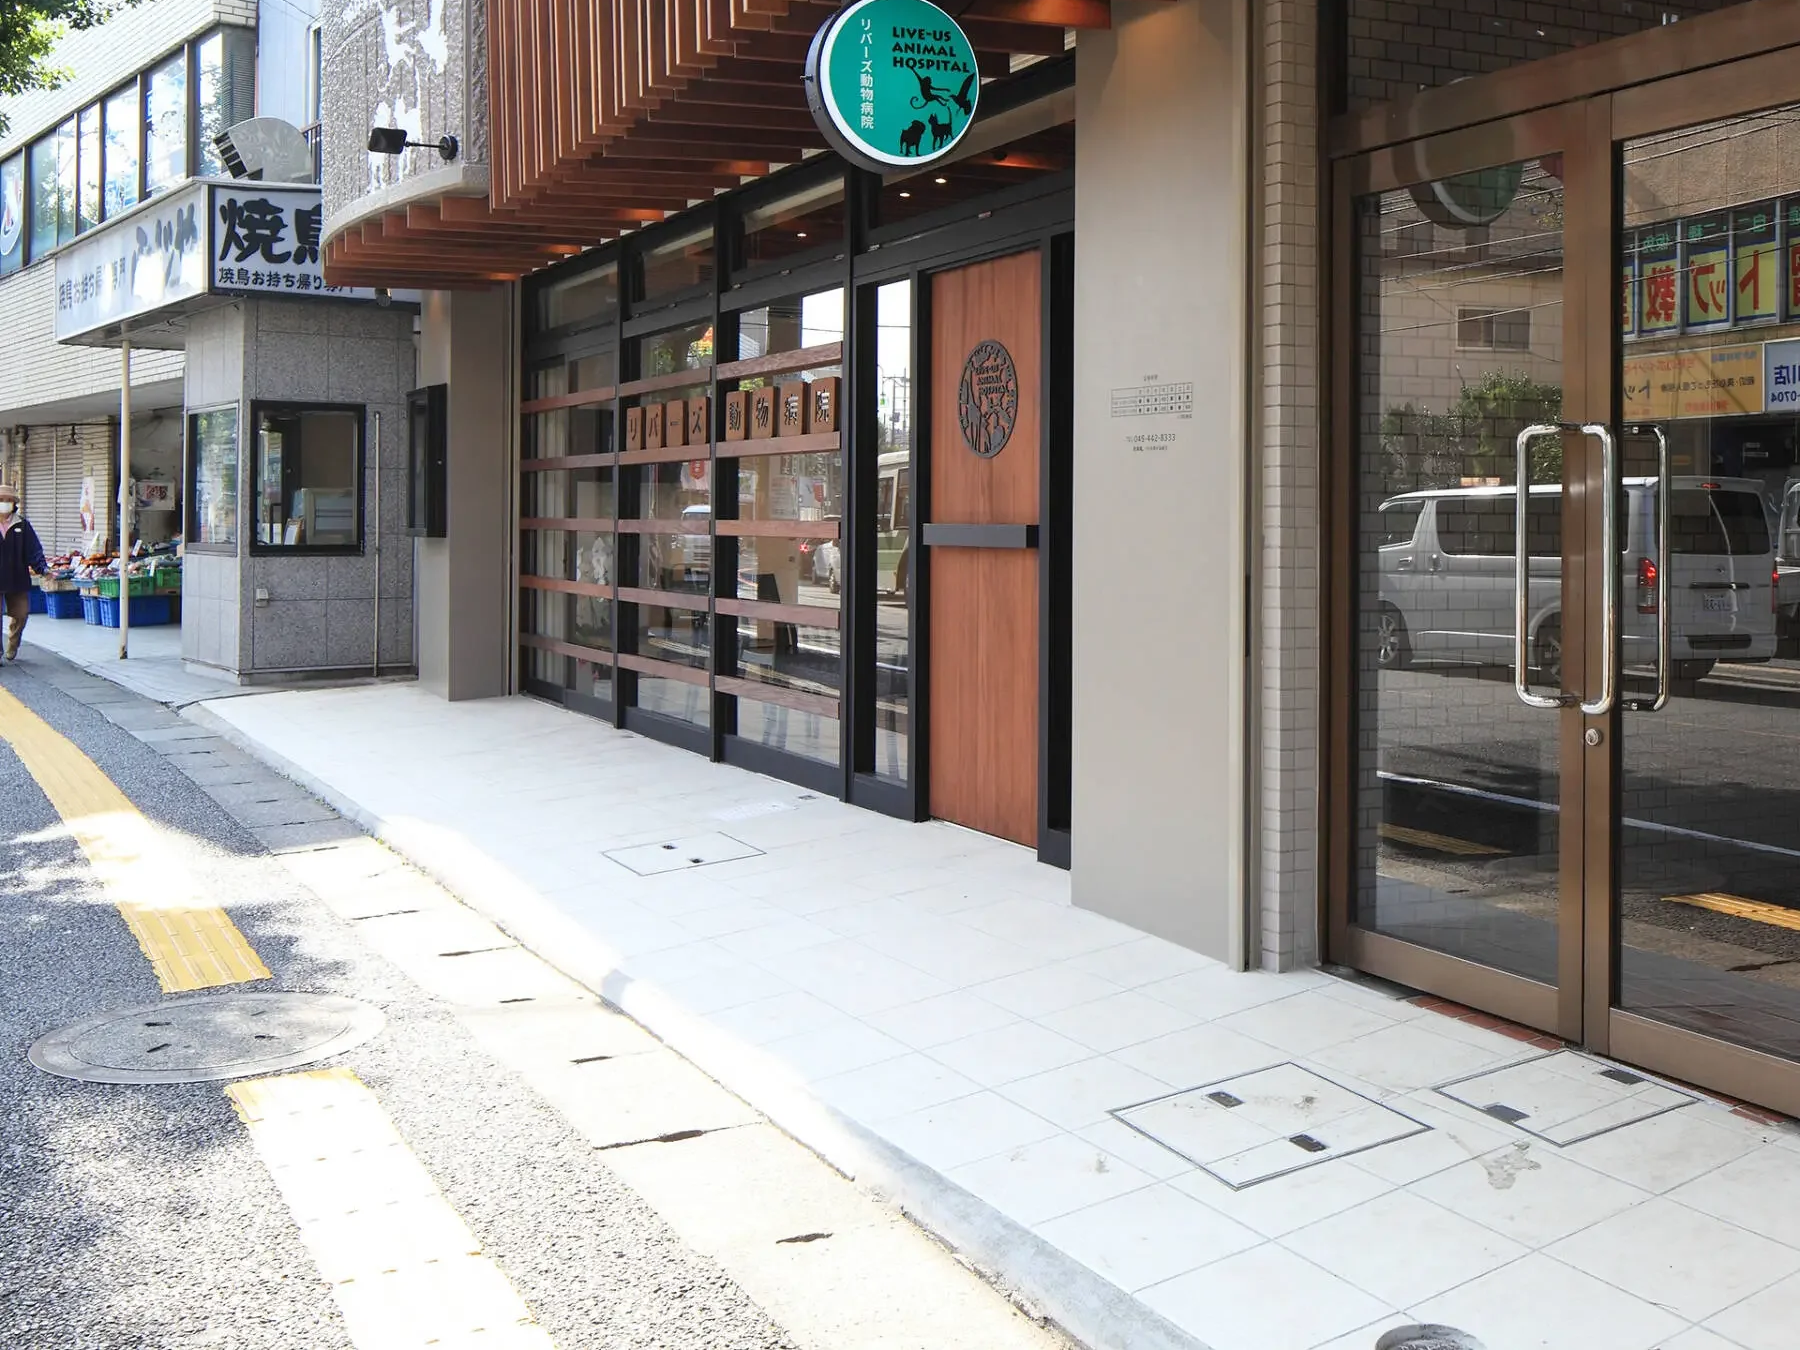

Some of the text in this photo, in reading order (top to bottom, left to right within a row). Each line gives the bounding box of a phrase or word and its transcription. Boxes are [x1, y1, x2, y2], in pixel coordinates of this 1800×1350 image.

[892, 26, 951, 42] LIVE-US
[892, 43, 957, 57] ANIMAL
[893, 58, 970, 73] HOSPITAL
[860, 18, 874, 130] リバーズ動物病院
[218, 267, 354, 293] 焼鳥お持ち帰り
